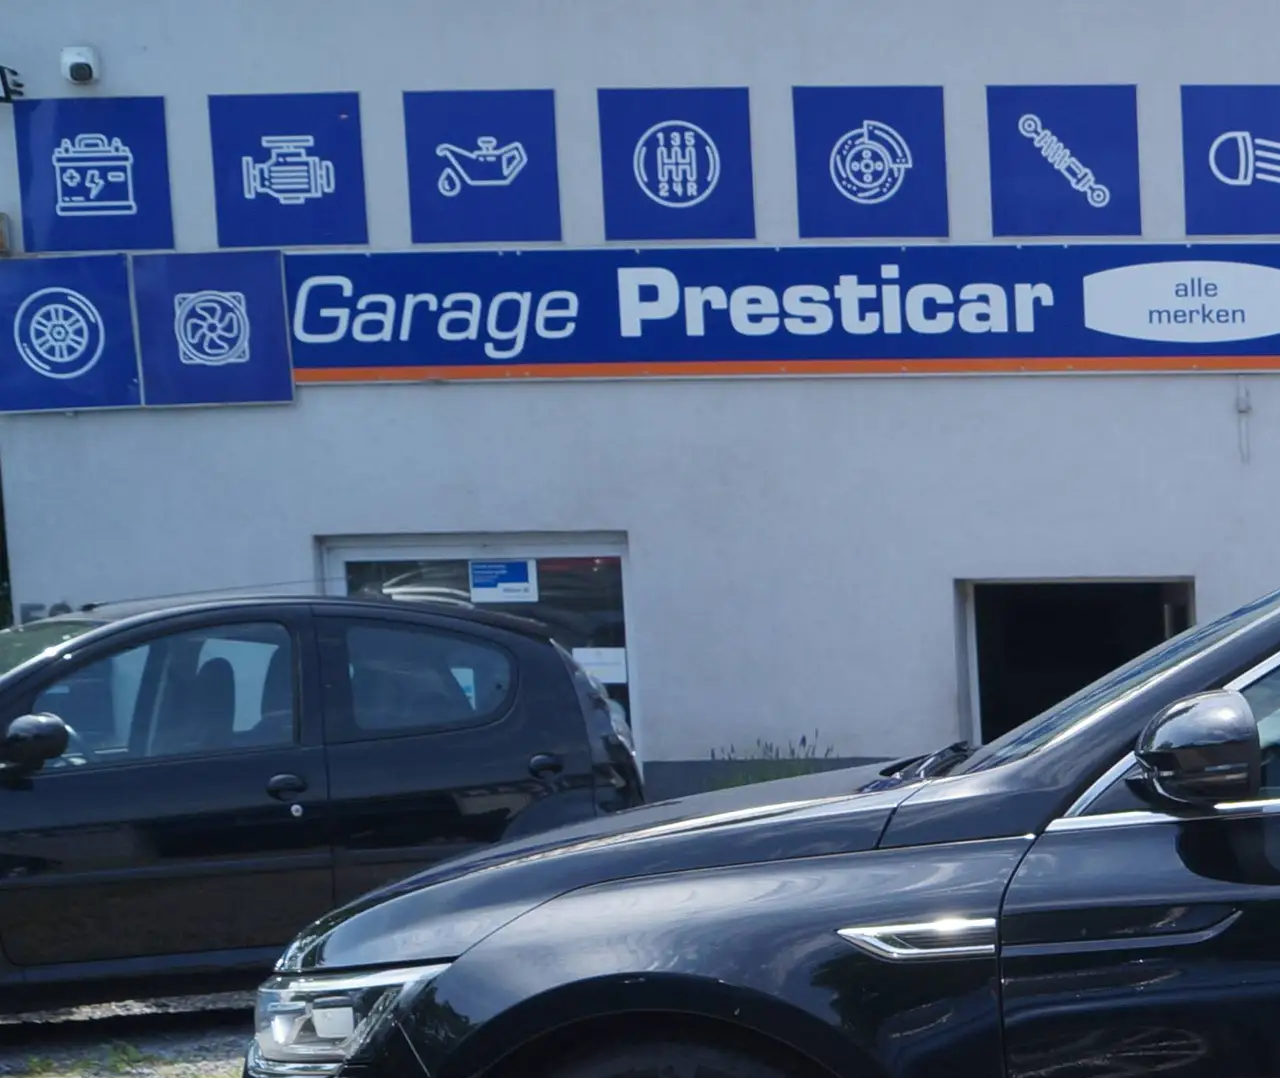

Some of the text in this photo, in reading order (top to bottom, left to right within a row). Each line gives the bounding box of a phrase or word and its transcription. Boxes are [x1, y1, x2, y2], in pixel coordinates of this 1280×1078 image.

[1174, 276, 1218, 298] alle
[294, 264, 1053, 360] Garage Presticar
[1148, 303, 1246, 325] merken
